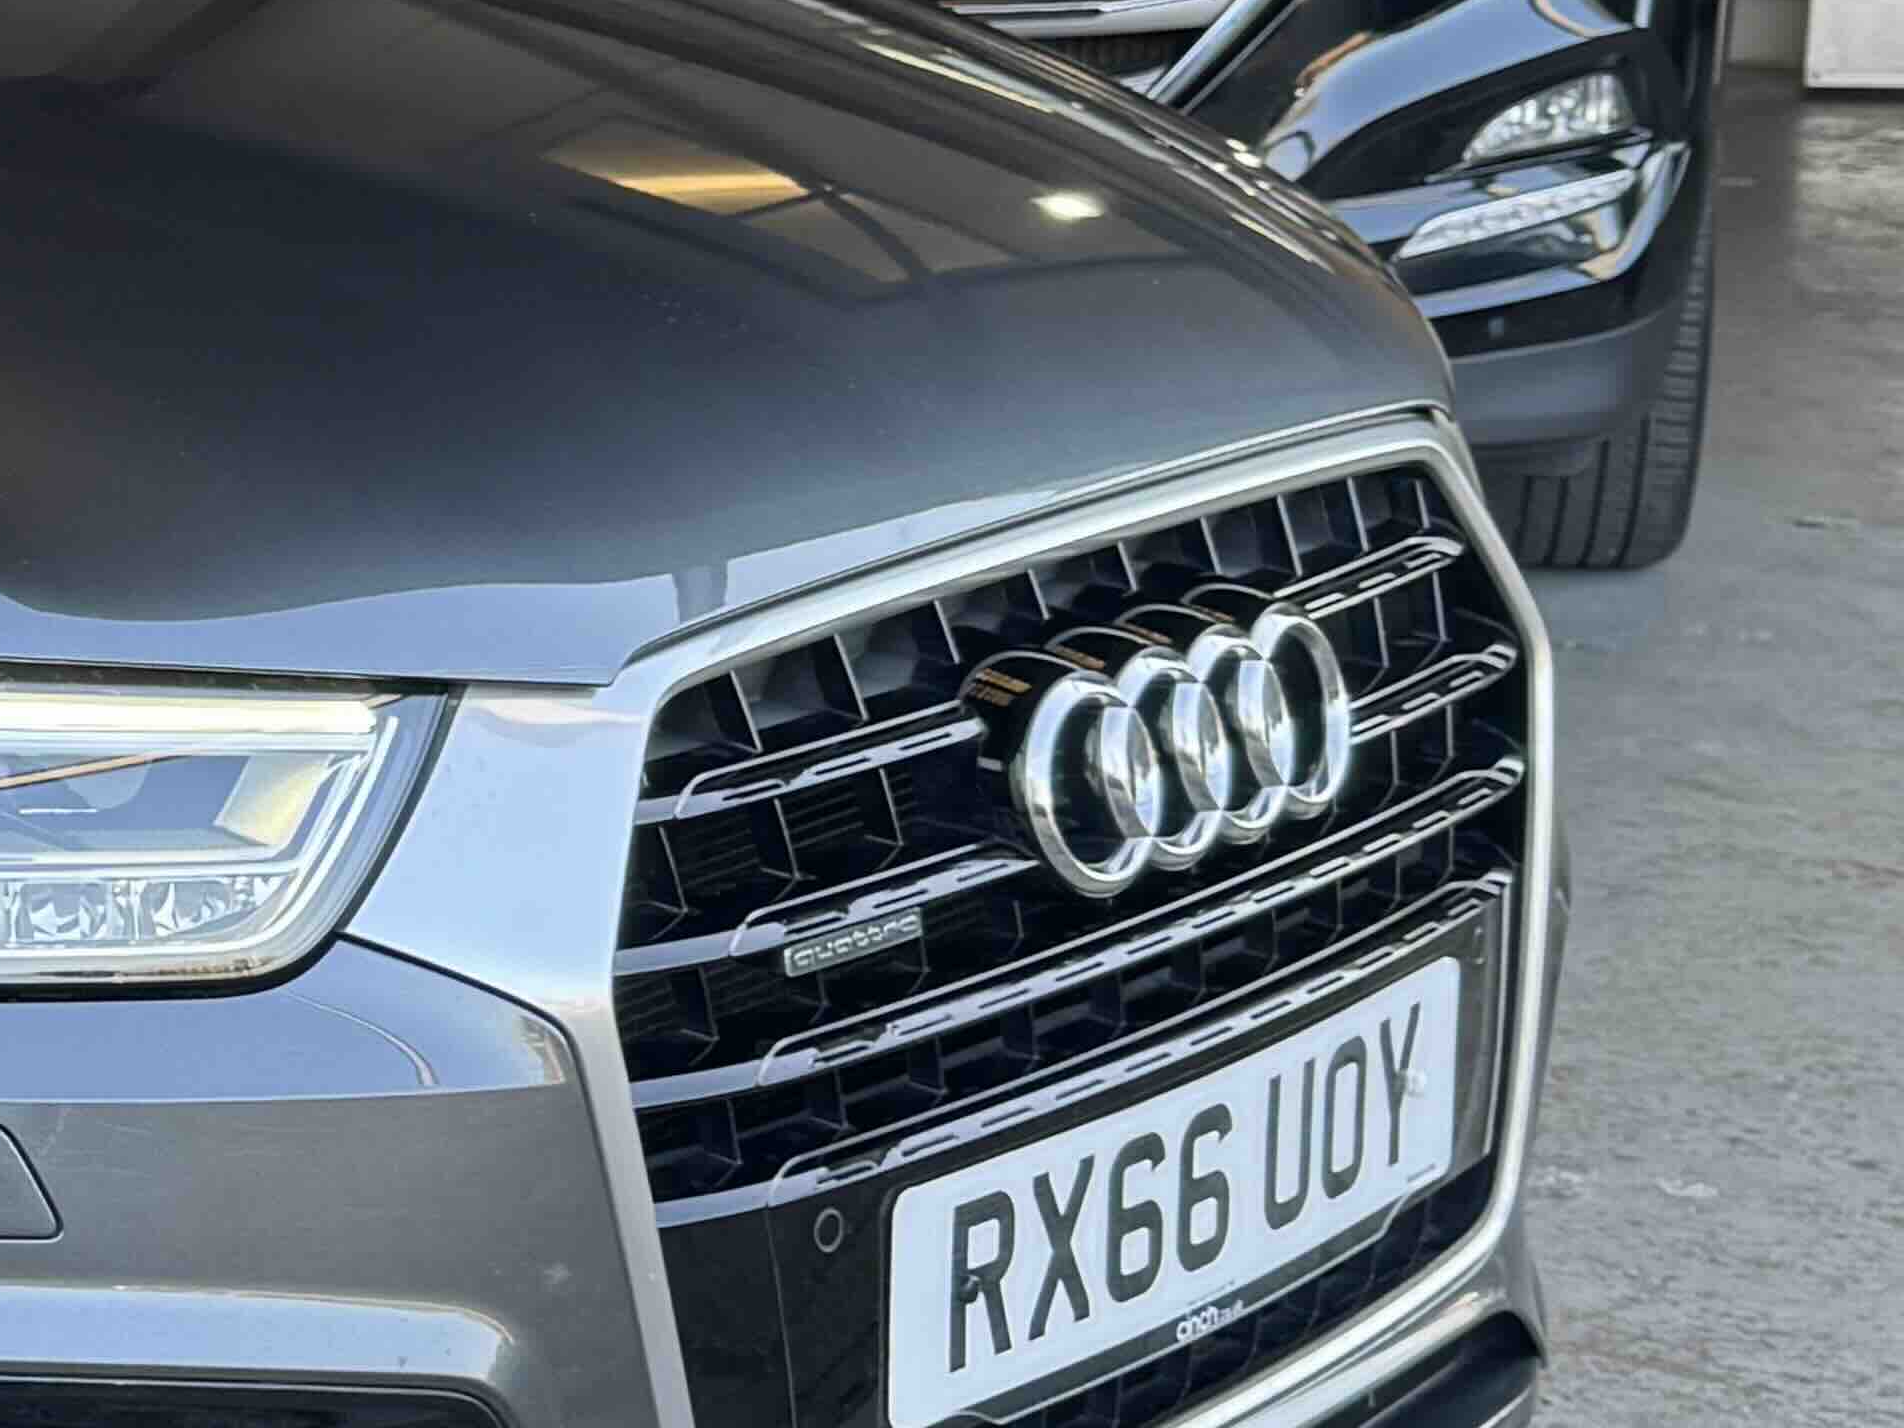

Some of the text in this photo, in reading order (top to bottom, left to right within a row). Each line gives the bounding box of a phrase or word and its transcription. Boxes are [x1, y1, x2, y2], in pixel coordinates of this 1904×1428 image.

[793, 914, 920, 967] quattro
[949, 1001, 1421, 1373] RX66 UOY
